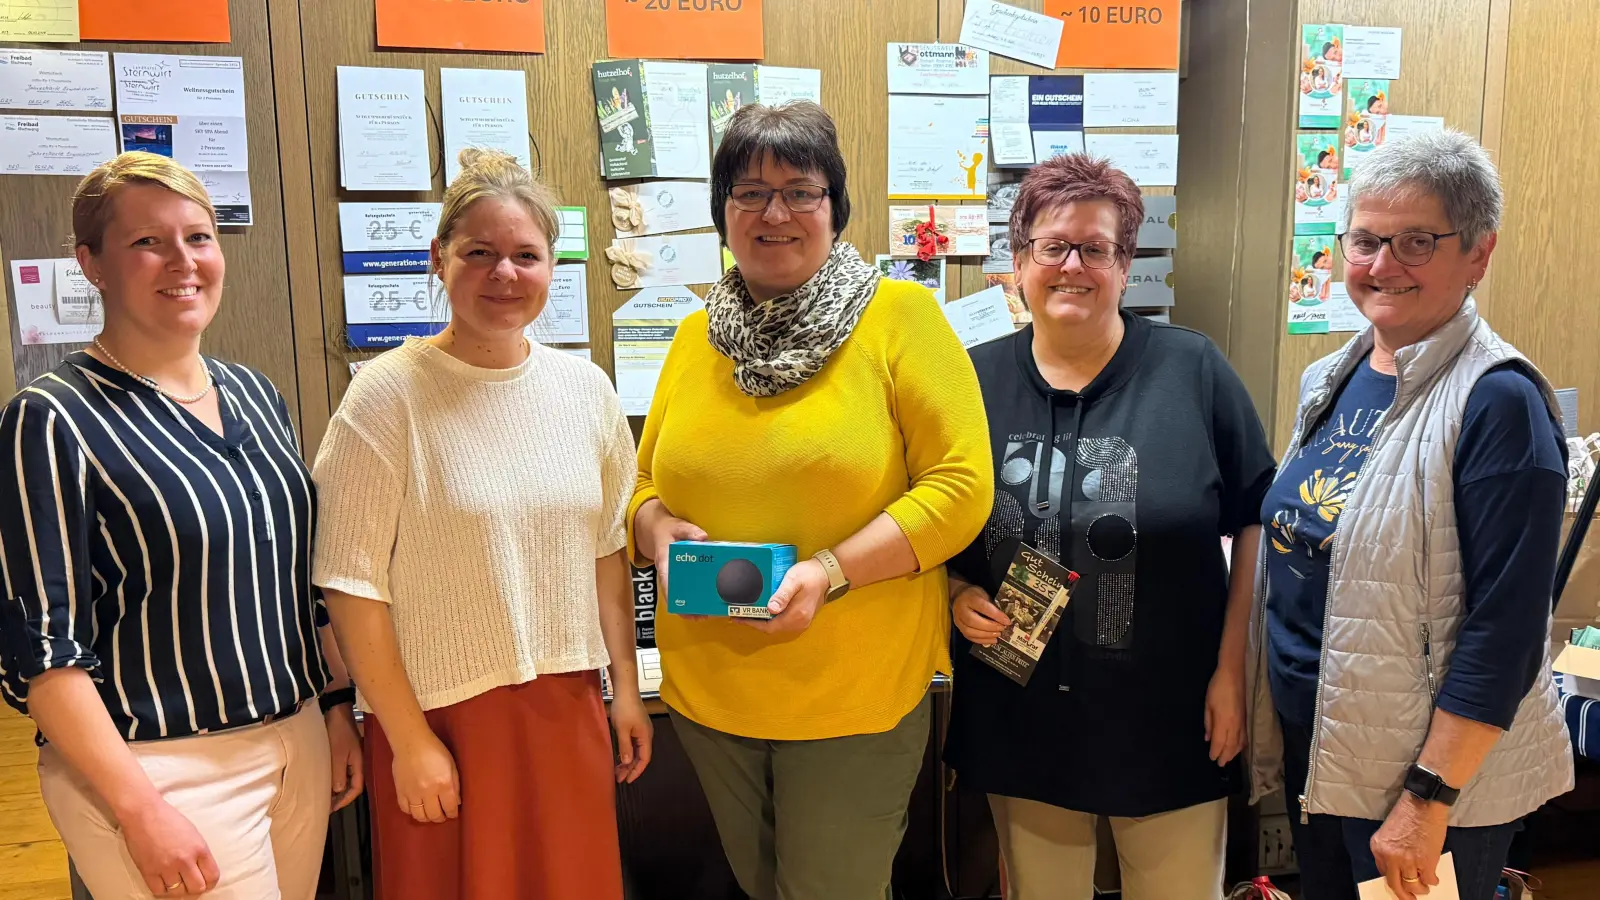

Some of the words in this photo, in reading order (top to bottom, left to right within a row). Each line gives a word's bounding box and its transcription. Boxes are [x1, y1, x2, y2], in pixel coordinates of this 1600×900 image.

[678, 0, 742, 11] EURO
[1078, 6, 1100, 24] 10
[1106, 6, 1163, 24] EURO
[123, 66, 172, 78] Sternwirt
[597, 67, 631, 78] hutzelhof
[713, 72, 746, 80] hutzelhof
[370, 220, 398, 240] 25
[409, 220, 423, 240] €
[903, 234, 916, 245] 10
[372, 291, 400, 311] 25
[413, 290, 427, 310] €
[676, 552, 696, 562] echo
[698, 554, 714, 562] dot
[1021, 552, 1043, 567] Gut
[1026, 564, 1064, 589] Schein
[1032, 581, 1048, 593] 35
[632, 570, 654, 621] black
